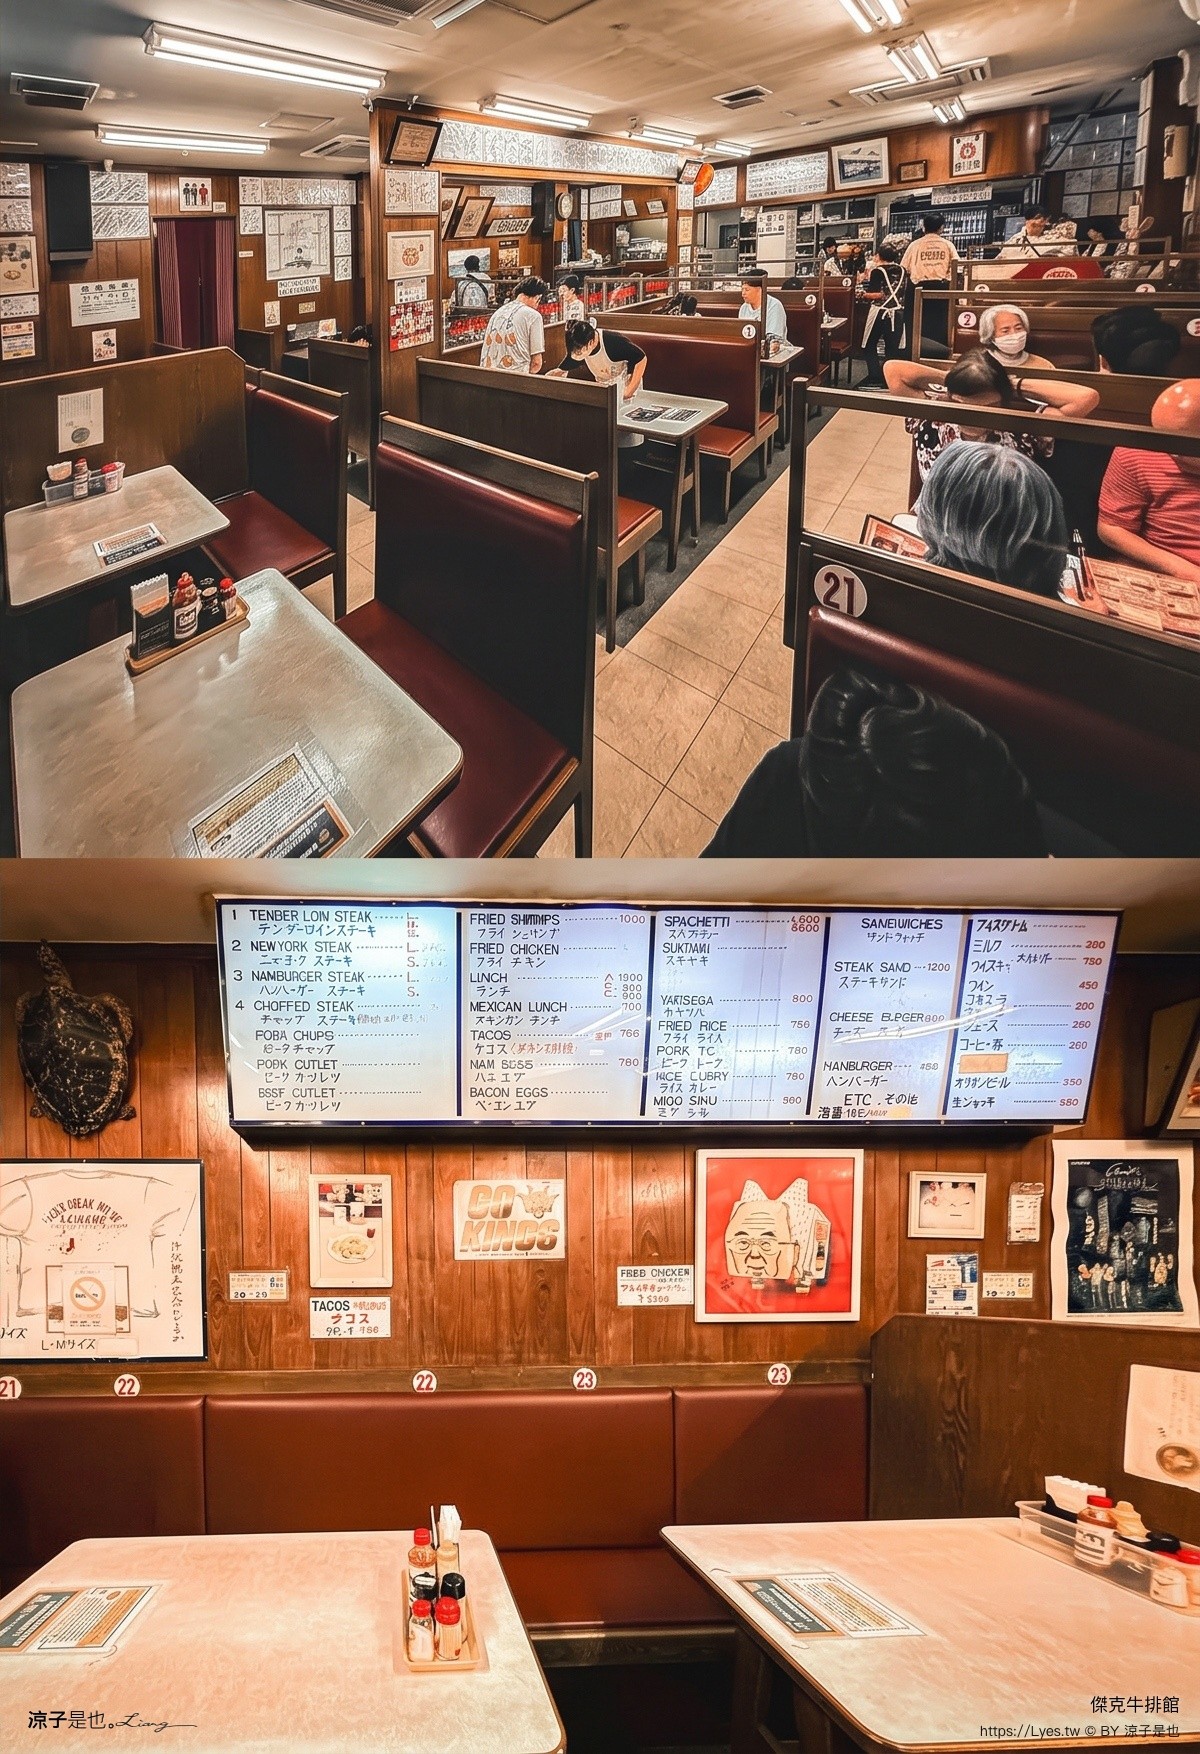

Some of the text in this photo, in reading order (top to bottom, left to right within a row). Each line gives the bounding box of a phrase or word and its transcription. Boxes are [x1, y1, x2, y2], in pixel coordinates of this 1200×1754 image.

[823, 572, 855, 614] 21
[232, 910, 237, 920] 1
[303, 911, 330, 922] LOIN
[334, 911, 373, 923] STEAK
[470, 914, 505, 925] FRIED
[620, 915, 645, 924] 1000
[477, 928, 505, 939] フライ
[231, 940, 242, 951] 2
[314, 941, 352, 952] STEAK
[470, 943, 559, 955] FRIED CHICKEN
[973, 940, 1105, 952] ミルク 280
[477, 957, 546, 968] フライ チキン
[834, 961, 950, 972] STEAK SAND 1200
[233, 971, 243, 981] 3
[327, 972, 365, 983] STEAK
[477, 985, 510, 997] ランチ
[792, 995, 813, 1003] 800
[235, 1000, 244, 1010] 4
[317, 1001, 354, 1012] STEAK
[470, 1001, 521, 1012] MEXICAN
[529, 1002, 567, 1012] LUNCH
[830, 1012, 873, 1022] CHEESE
[658, 1021, 692, 1031] FRIED
[700, 1021, 727, 1031] RICE
[470, 1030, 511, 1040] TACOS
[657, 1046, 690, 1056] PORK
[295, 1060, 338, 1070] CUTLET
[619, 1058, 639, 1067] 780
[292, 1088, 336, 1098] CUTLET
[470, 1087, 548, 1097] BACON EGGS
[660, 1083, 683, 1094] ライス
[312, 1300, 350, 1311] TACOS
[576, 1372, 593, 1388] 23
[771, 1367, 788, 1383] 23
[118, 1379, 136, 1395] 22
[416, 1374, 433, 1391] 22
[0, 1380, 16, 1397] 21
